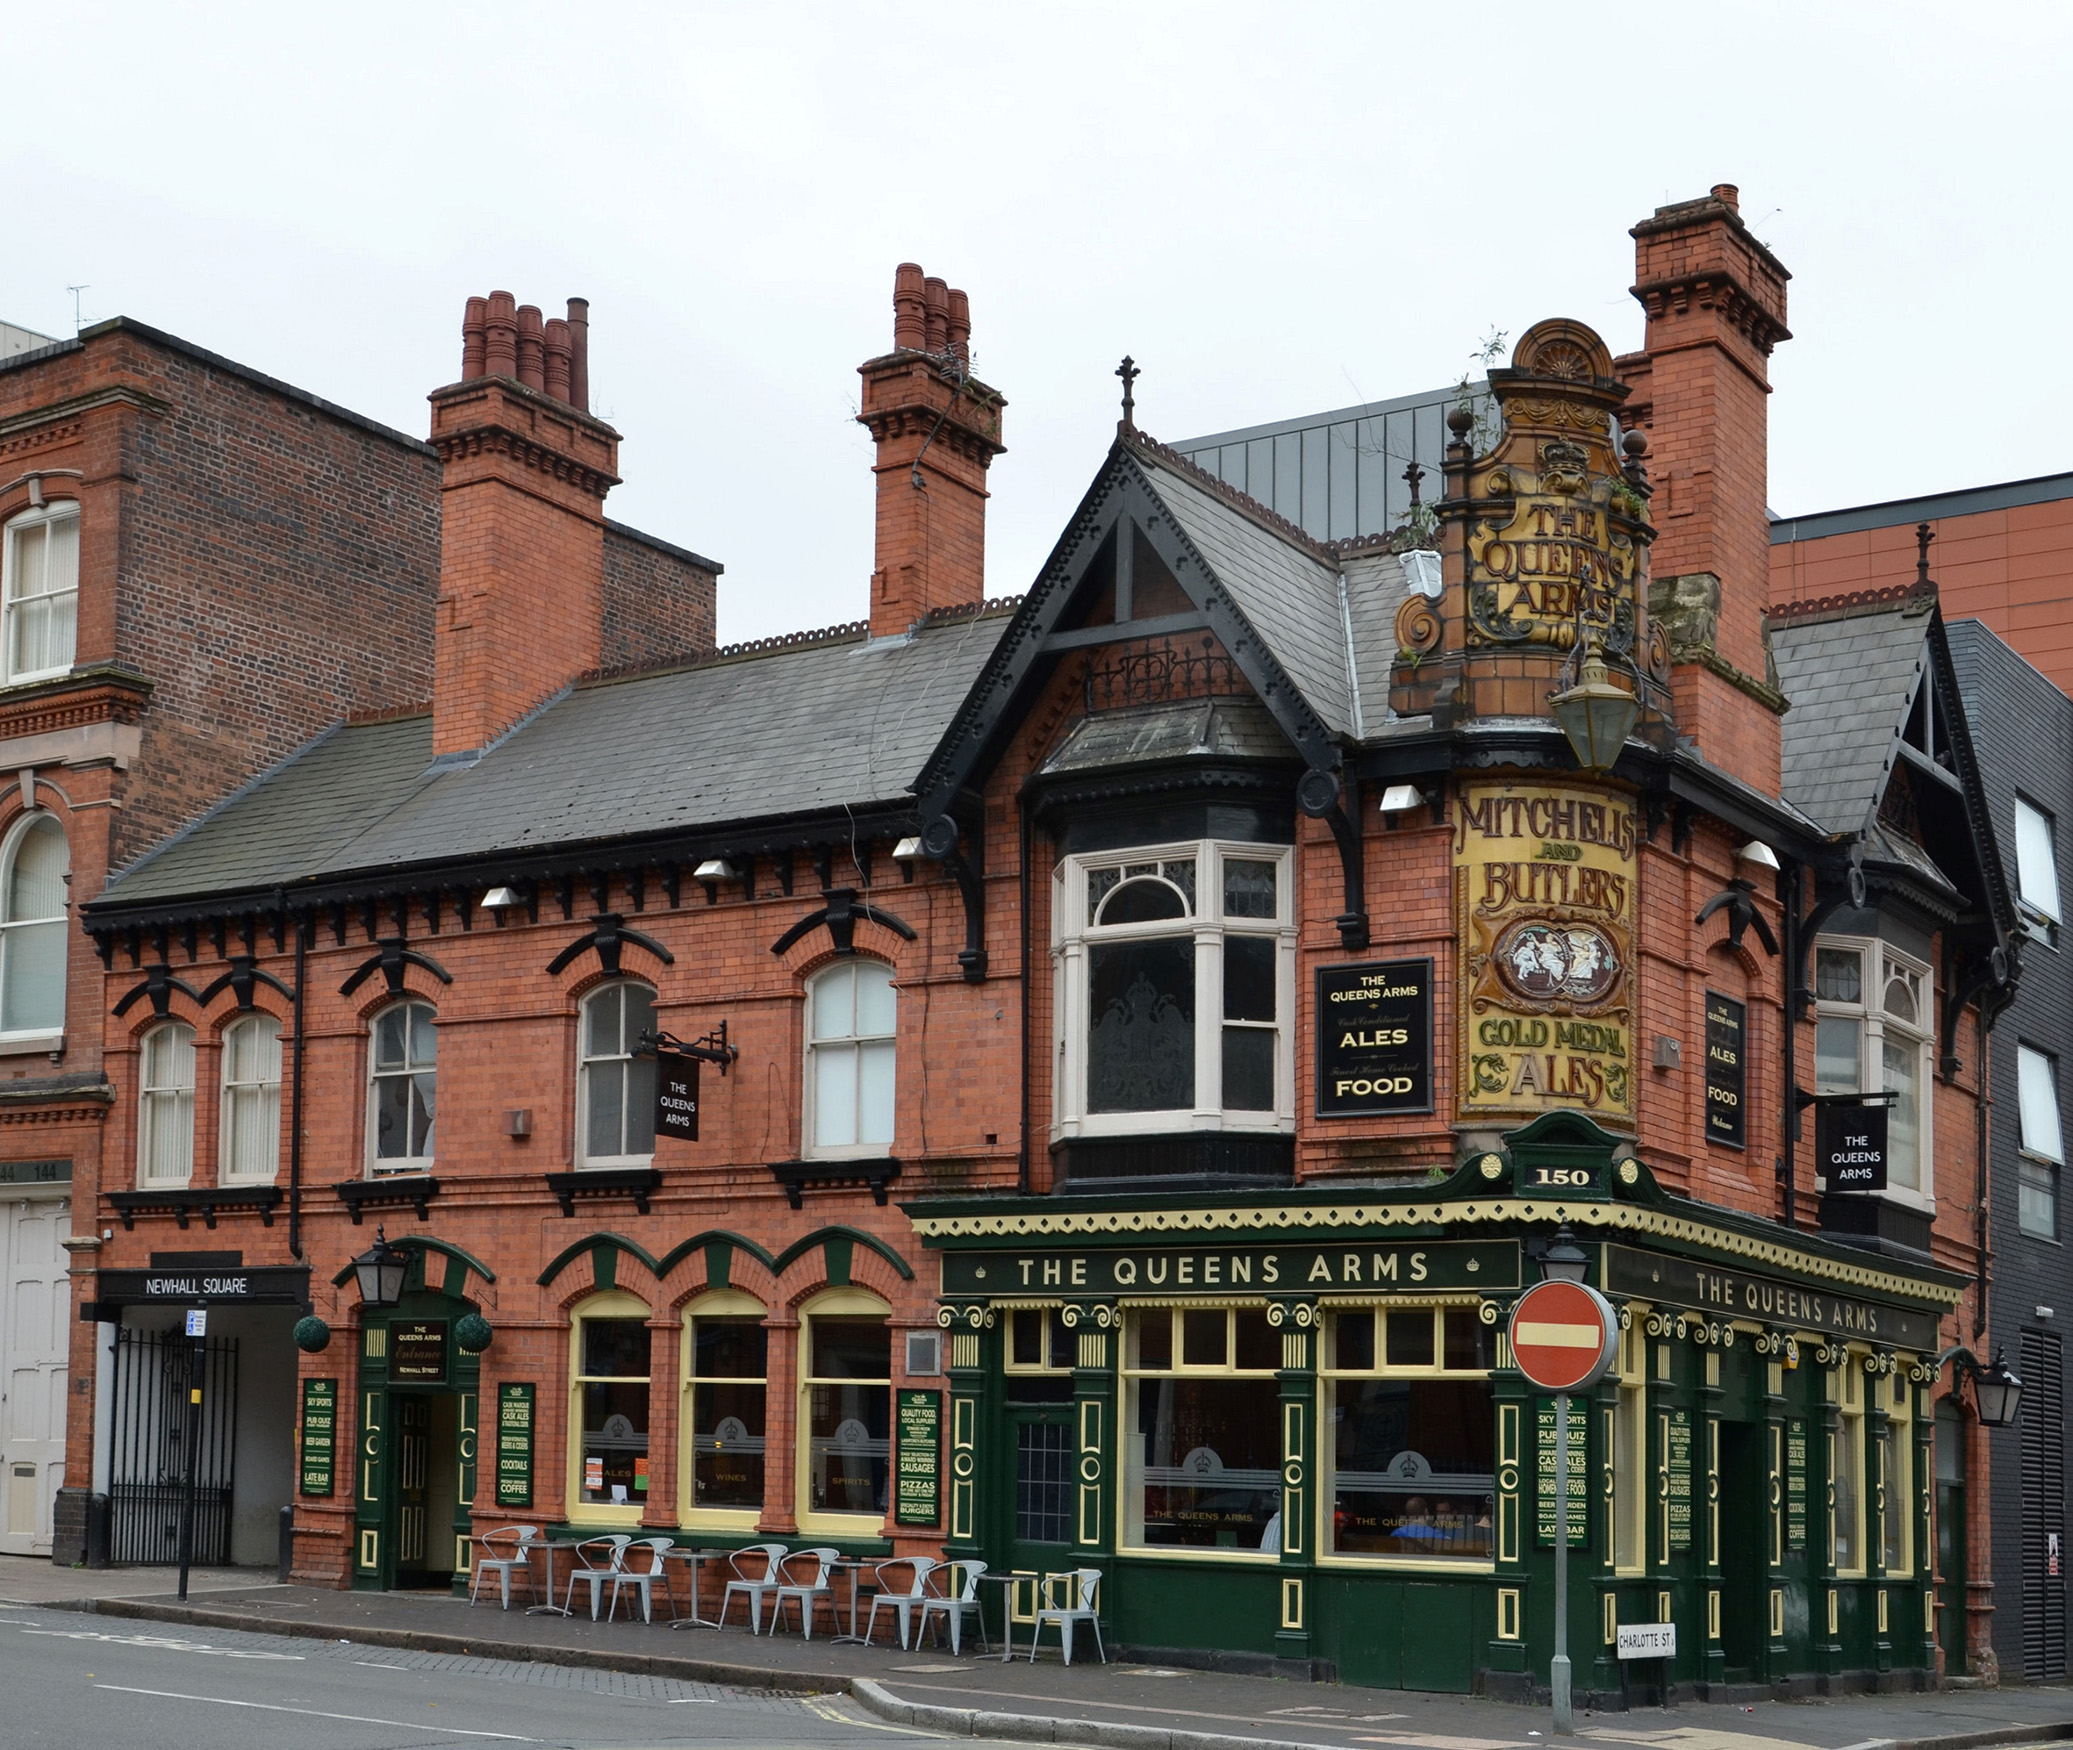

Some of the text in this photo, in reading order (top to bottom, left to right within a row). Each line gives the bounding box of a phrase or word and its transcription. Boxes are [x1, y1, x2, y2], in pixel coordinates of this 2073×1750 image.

[1528, 504, 1598, 545] THE
[1482, 540, 1624, 595] QUEENS
[1505, 582, 1611, 622] ARMS
[1456, 797, 1636, 861] MITCHELLS
[1535, 842, 1583, 861] AND
[1481, 862, 1626, 919] BUTLERS
[1360, 975, 1386, 987] THE
[1330, 986, 1418, 1003] QUEENS ARMS
[1718, 1006, 1728, 1016] THE
[1708, 1011, 1738, 1029] QUEENS ARMS
[1339, 1029, 1408, 1048] ALES
[1479, 1019, 1626, 1058] GOLD MEDAL
[1710, 1046, 1736, 1065] ALES
[1336, 1077, 1413, 1097] FOOD
[1510, 1054, 1603, 1107] ALES
[670, 1081, 688, 1095] THE
[1708, 1086, 1738, 1106] FOOD
[660, 1096, 696, 1112] QUEENS
[666, 1113, 690, 1127] ARMS
[1712, 1114, 1733, 1131] Welcome
[1844, 1135, 1868, 1147] THE
[1831, 1151, 1881, 1164] QUEENS
[34, 1163, 57, 1181] 144
[1536, 1169, 1590, 1186] 150
[1839, 1168, 1873, 1180] ARMS
[1018, 1251, 1429, 1286] THE QUEENS ARMS
[146, 1278, 248, 1294] NEWHALL SQUARE
[1696, 1272, 1877, 1333] THE QUEENS ARMS
[502, 1412, 529, 1421] CASK ALES
[901, 1409, 921, 1418] QUALITY
[1538, 1415, 1586, 1425] SKY ORTS
[307, 1416, 331, 1425] PUB QUIZ
[1538, 1430, 1586, 1441] PUB UIZ
[500, 1459, 528, 1470] COCKTAILS
[1538, 1456, 1557, 1465] CAS
[604, 1469, 632, 1478] ALES
[900, 1463, 935, 1473] SAUSAGES
[305, 1472, 329, 1483] LATE BAR
[715, 1473, 748, 1482] WINES
[832, 1477, 871, 1486] SPIRITS
[500, 1484, 528, 1494] COFFEE
[900, 1480, 935, 1489] PIZZAS
[1570, 1484, 1586, 1495] FOOD
[900, 1507, 935, 1515] BURGERS
[1670, 1505, 1691, 1513] PIZZAS
[1153, 1510, 1253, 1522] THE QUEENS ARMS
[1355, 1517, 1377, 1526] THE
[1432, 1519, 1464, 1529] ARMS
[1538, 1525, 1557, 1533] LAT
[1619, 1633, 1659, 1649] CHARLOTTE
[1661, 1632, 1671, 1647] ST
